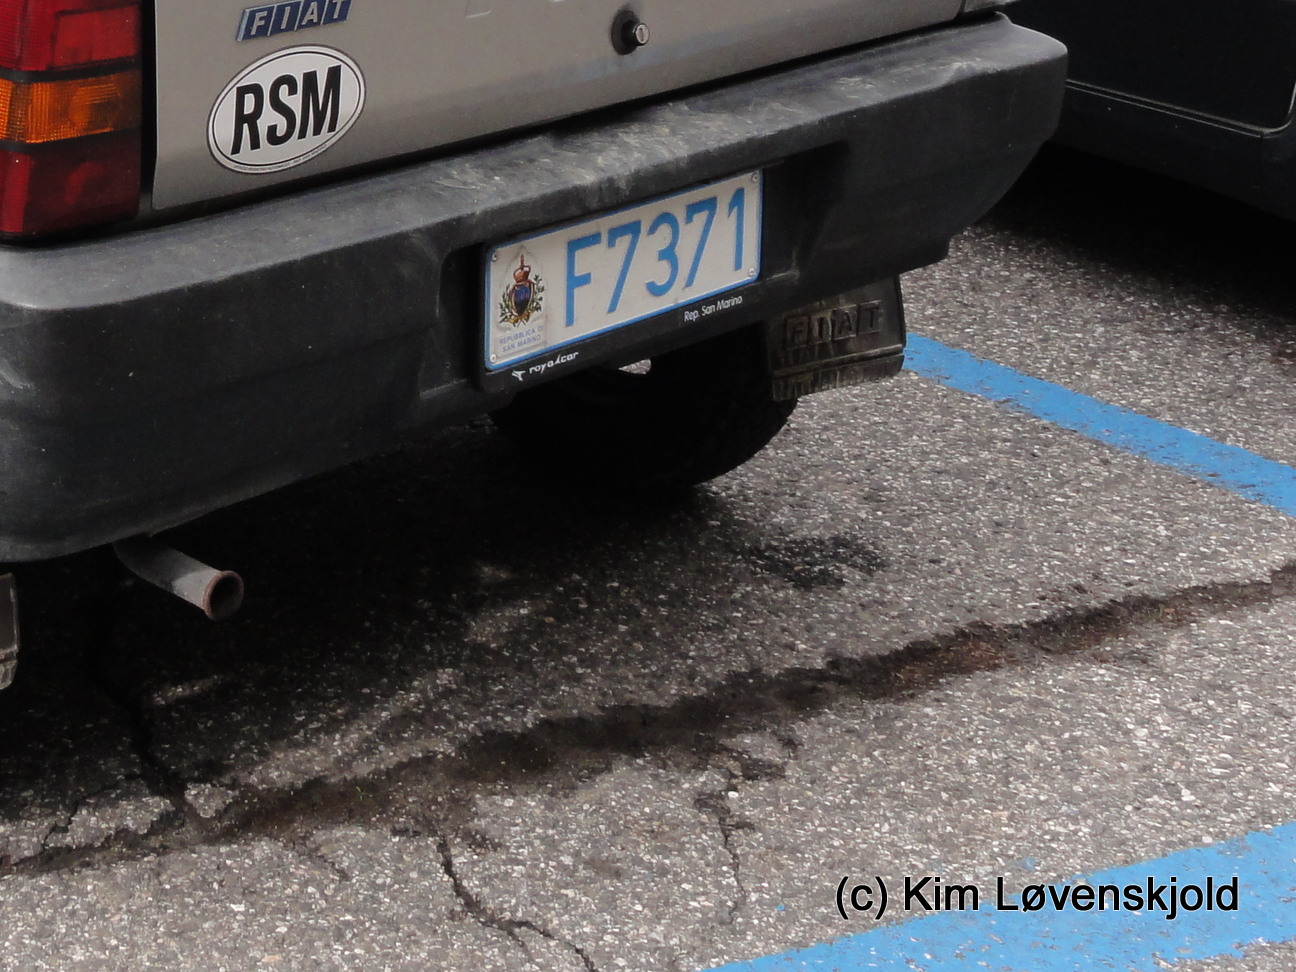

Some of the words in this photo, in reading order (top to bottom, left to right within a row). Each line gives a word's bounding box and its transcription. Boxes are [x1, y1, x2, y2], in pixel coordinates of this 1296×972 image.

[230, 64, 342, 156] RSM
[565, 187, 746, 328] F7371
[684, 310, 700, 322] Rep.
[701, 305, 716, 316] San
[716, 295, 743, 311] Marino
[791, 303, 881, 344] FIAT
[499, 328, 535, 344] REPUBBLICA
[502, 343, 515, 353] SAN
[517, 334, 541, 347] MARINO
